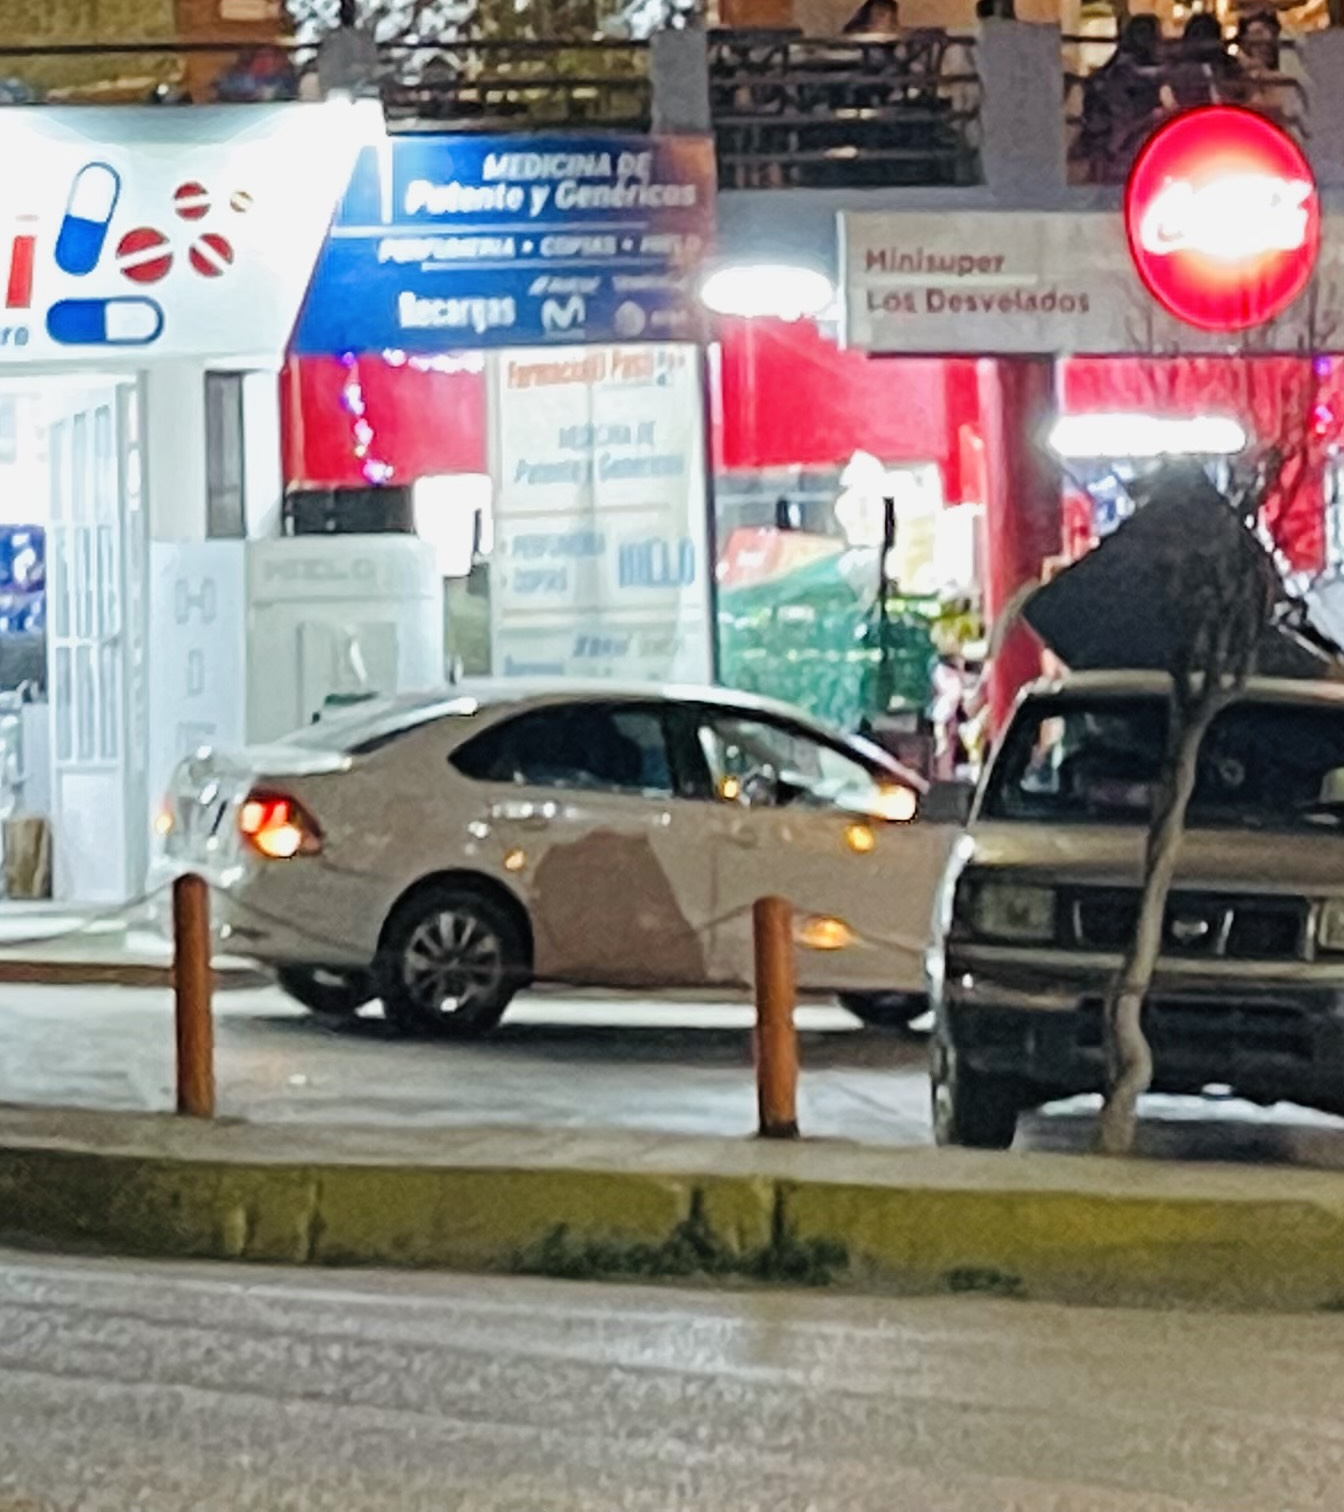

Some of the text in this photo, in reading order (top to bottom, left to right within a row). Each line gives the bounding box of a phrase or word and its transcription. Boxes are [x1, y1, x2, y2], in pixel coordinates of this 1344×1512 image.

[530, 184, 551, 217] y
[865, 247, 1004, 277] Minisuper
[867, 286, 1090, 314] Los Desvelados
